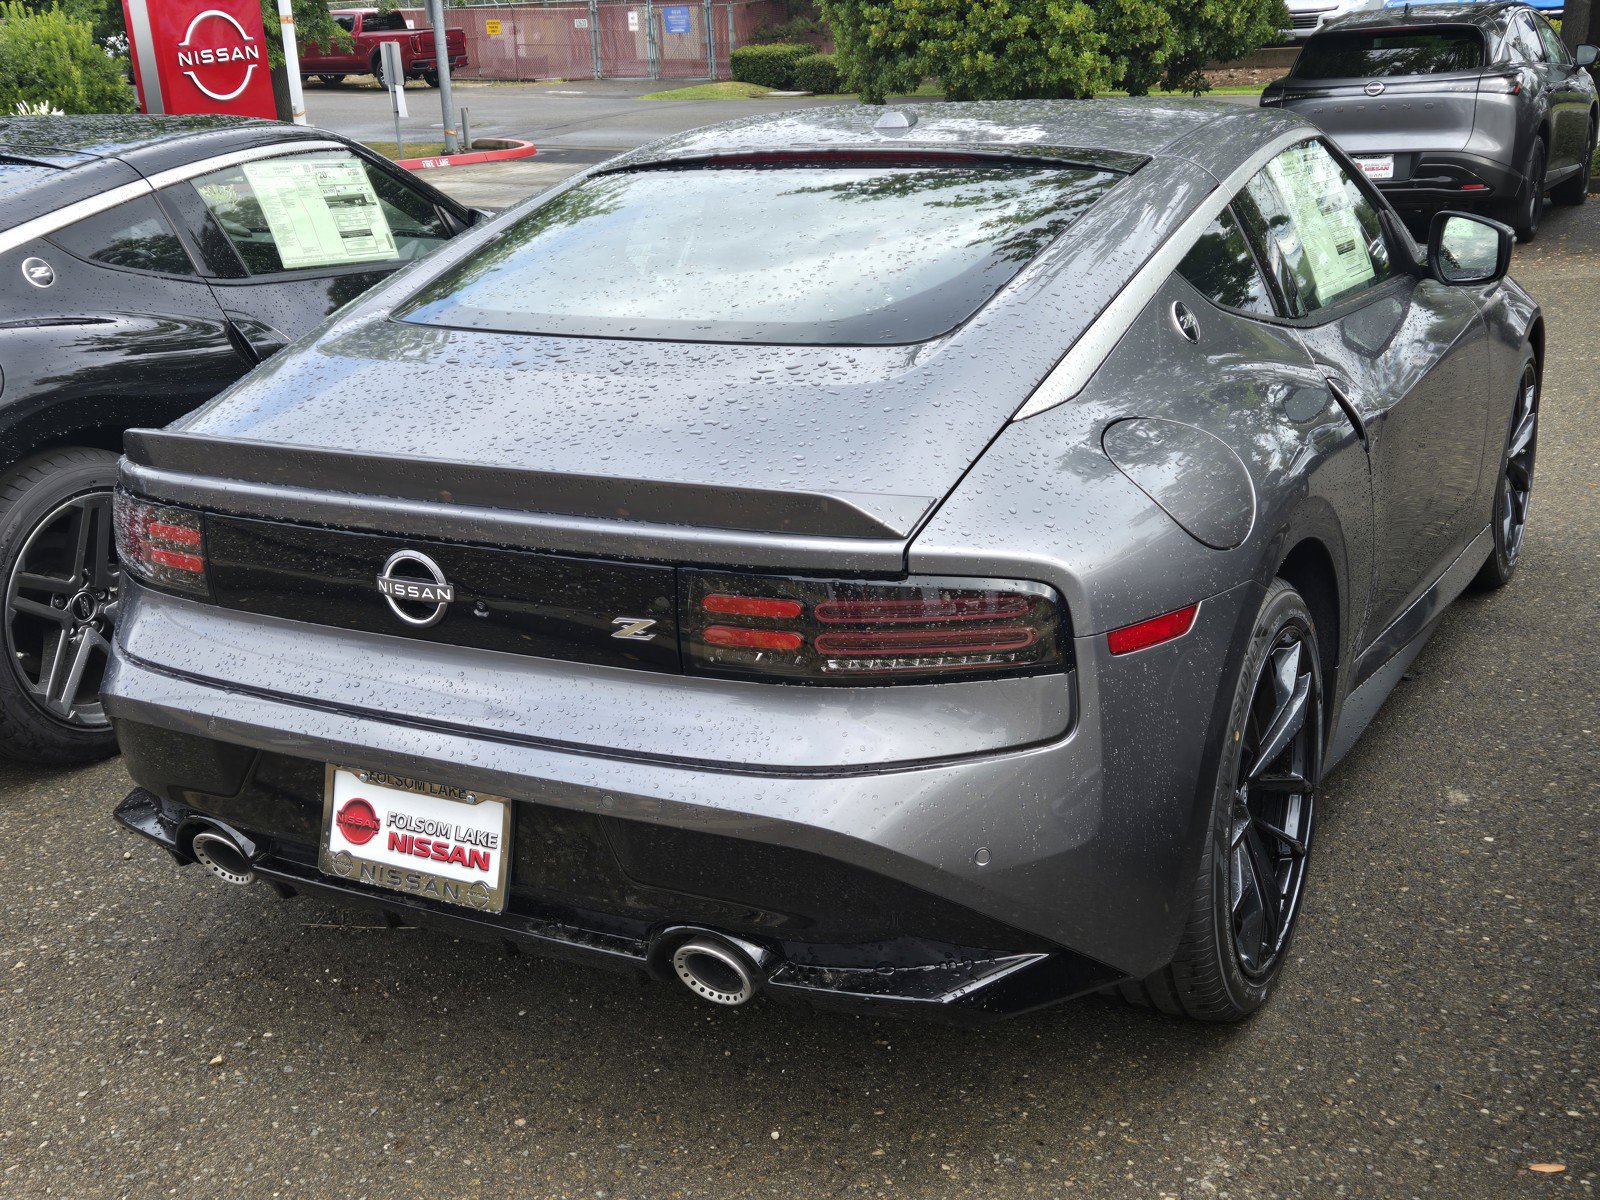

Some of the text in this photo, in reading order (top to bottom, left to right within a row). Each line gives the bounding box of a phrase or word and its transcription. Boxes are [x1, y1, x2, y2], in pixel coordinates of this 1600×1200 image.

[177, 44, 259, 66] NISSAN
[1313, 102, 1434, 114] MURANO
[421, 157, 450, 168] FIRE LANE
[378, 579, 451, 601] NISSAN
[611, 616, 657, 641] Z
[368, 770, 467, 799] FOLSOM LAKE
[336, 812, 380, 831] NISSAN
[386, 811, 499, 849] FOLSOM LAKE
[387, 830, 491, 872] NISSAN
[360, 862, 461, 900] NISSAN
